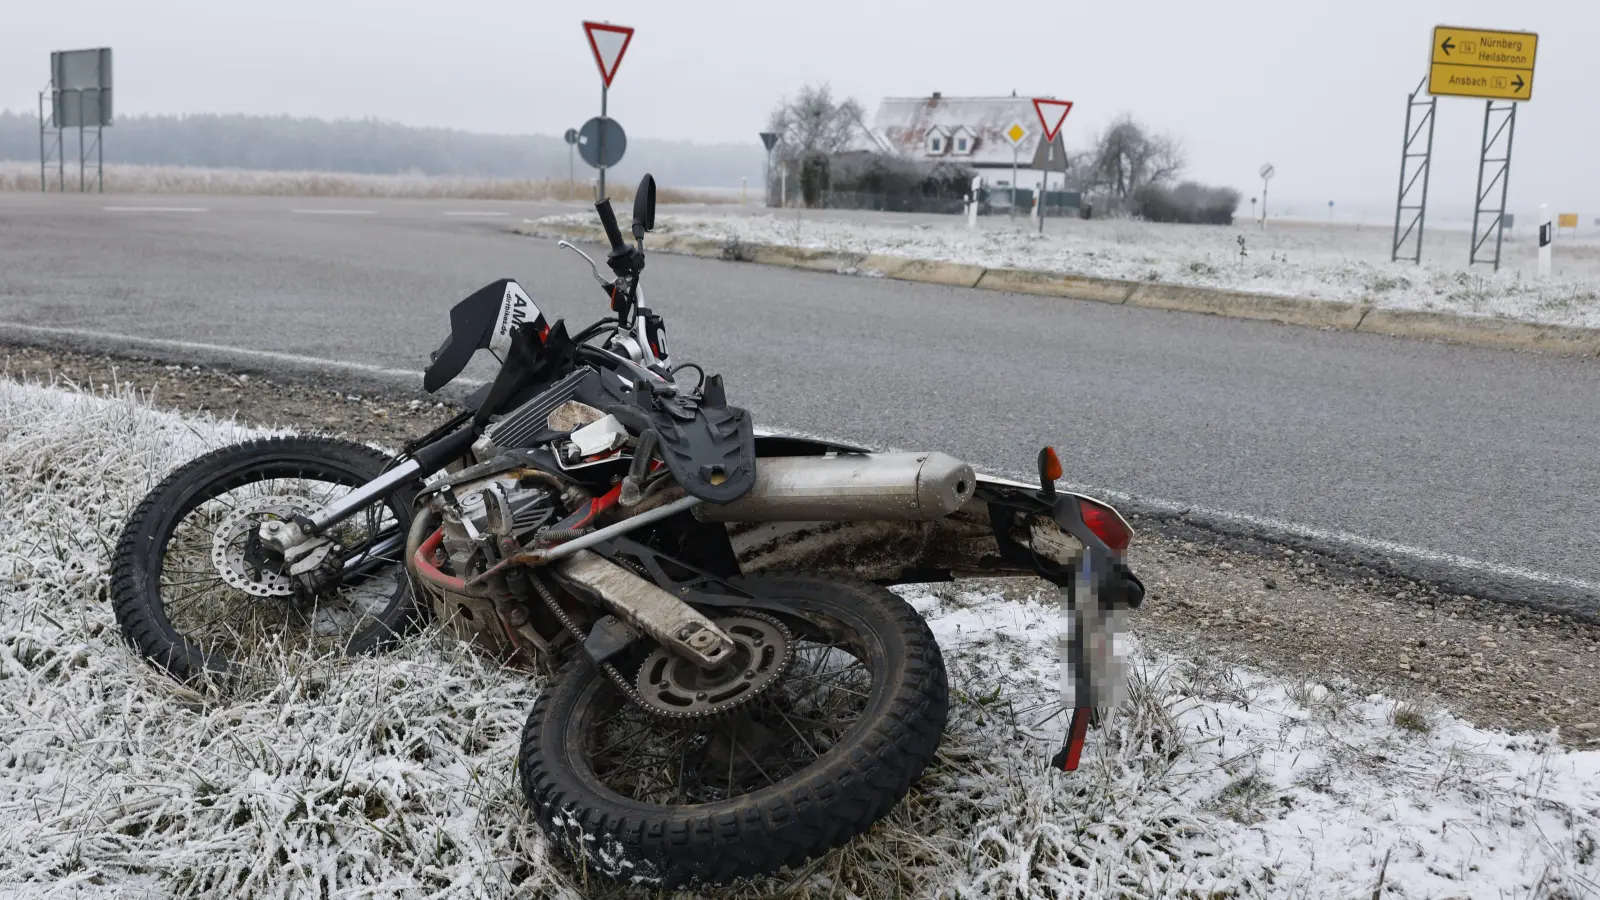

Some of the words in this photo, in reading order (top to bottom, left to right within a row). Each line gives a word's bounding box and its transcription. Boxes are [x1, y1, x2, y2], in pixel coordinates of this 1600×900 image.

[1480, 37, 1522, 52] Nürnberg
[1479, 51, 1526, 64] Heilsbronn
[1448, 75, 1487, 87] Ansbach
[511, 293, 527, 331] AM
